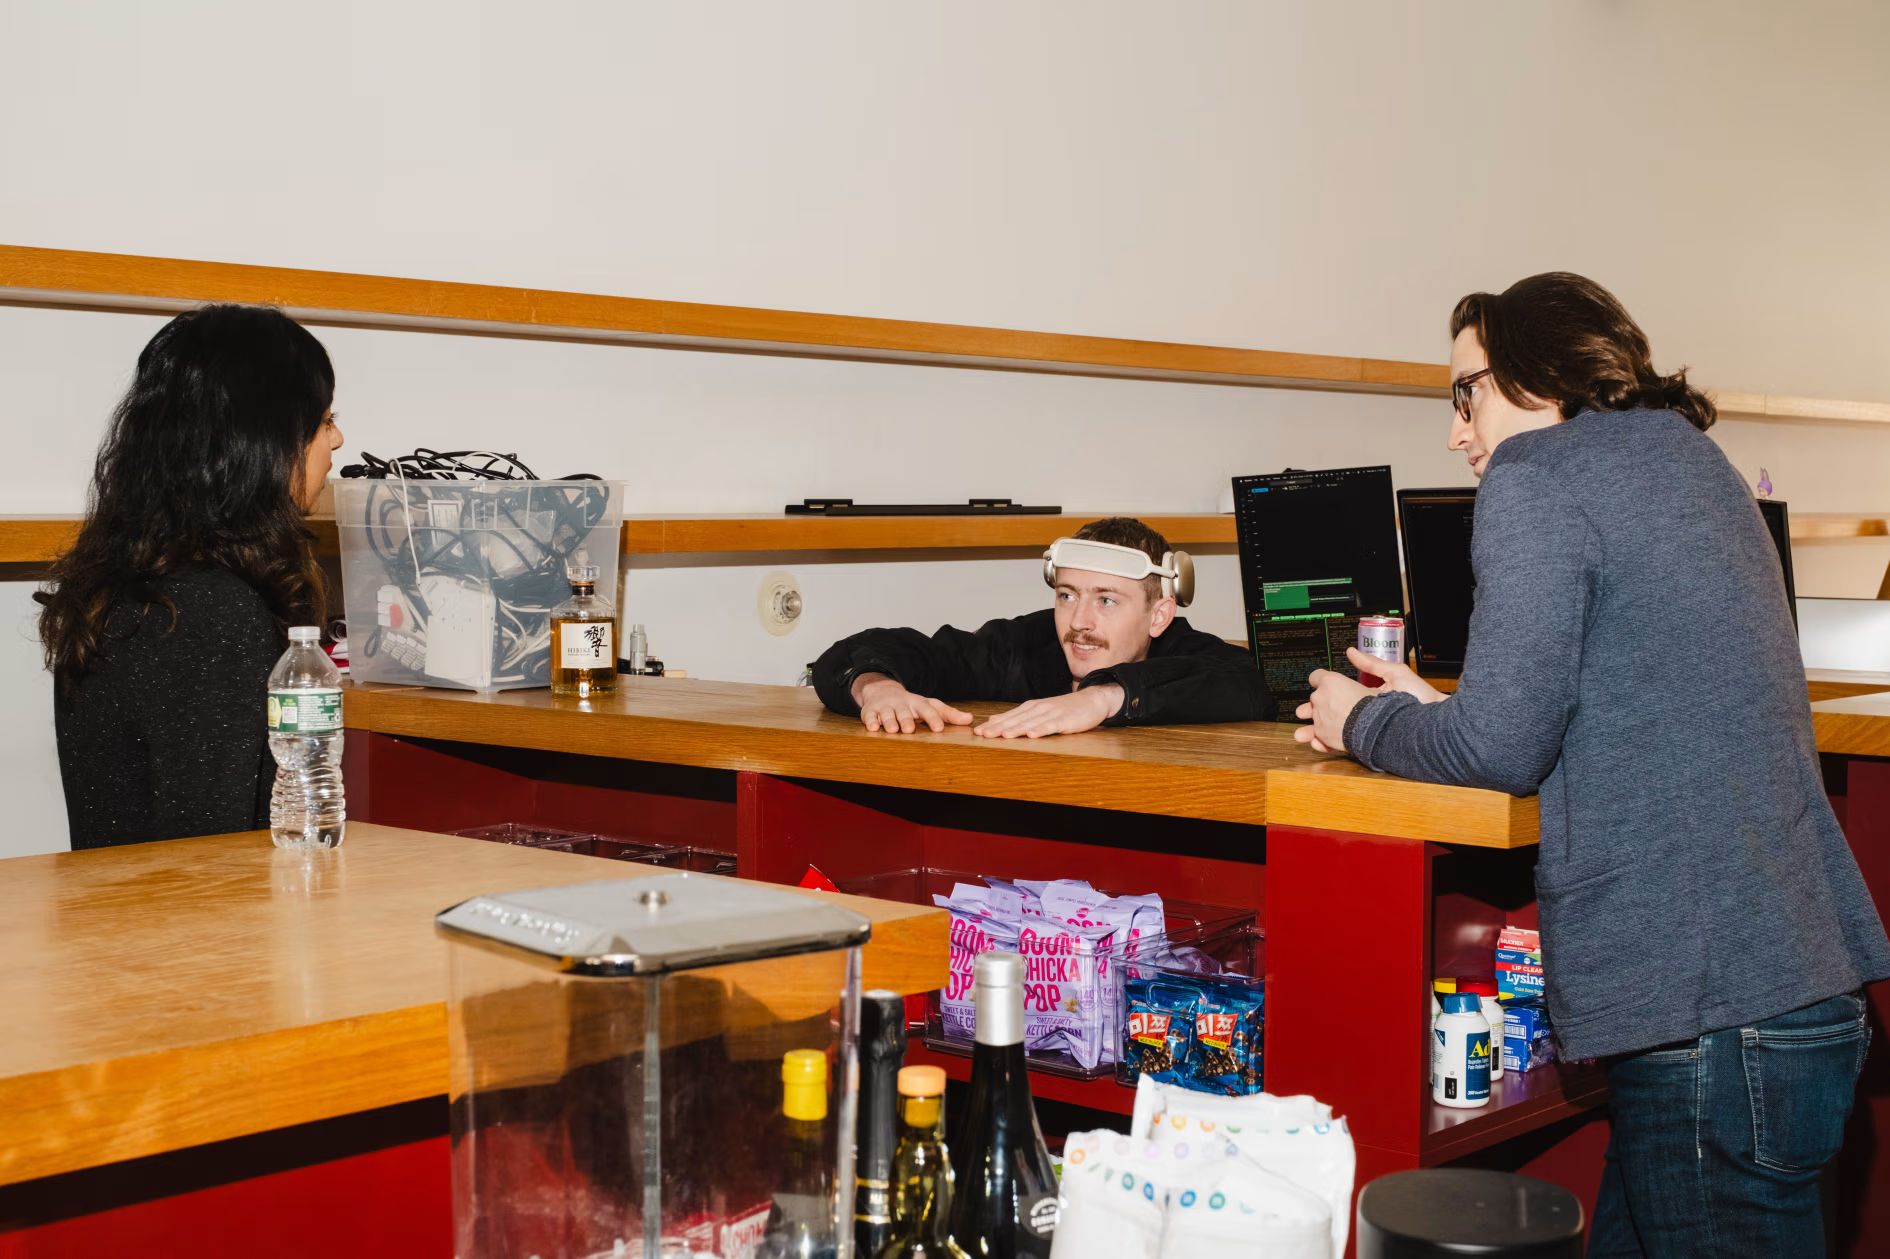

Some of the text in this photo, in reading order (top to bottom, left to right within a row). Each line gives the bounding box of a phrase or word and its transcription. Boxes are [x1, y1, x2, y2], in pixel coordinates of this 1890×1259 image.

[1363, 637, 1400, 649] Bloom
[950, 915, 995, 954] OOM
[950, 946, 976, 973] HIC
[945, 972, 974, 1001] OP
[1506, 970, 1546, 987] Lysine
[1024, 983, 1062, 1012] POP
[965, 1017, 976, 1029] CO
[1129, 1013, 1167, 1035] 미쯔
[1197, 1014, 1234, 1036] 미쯔
